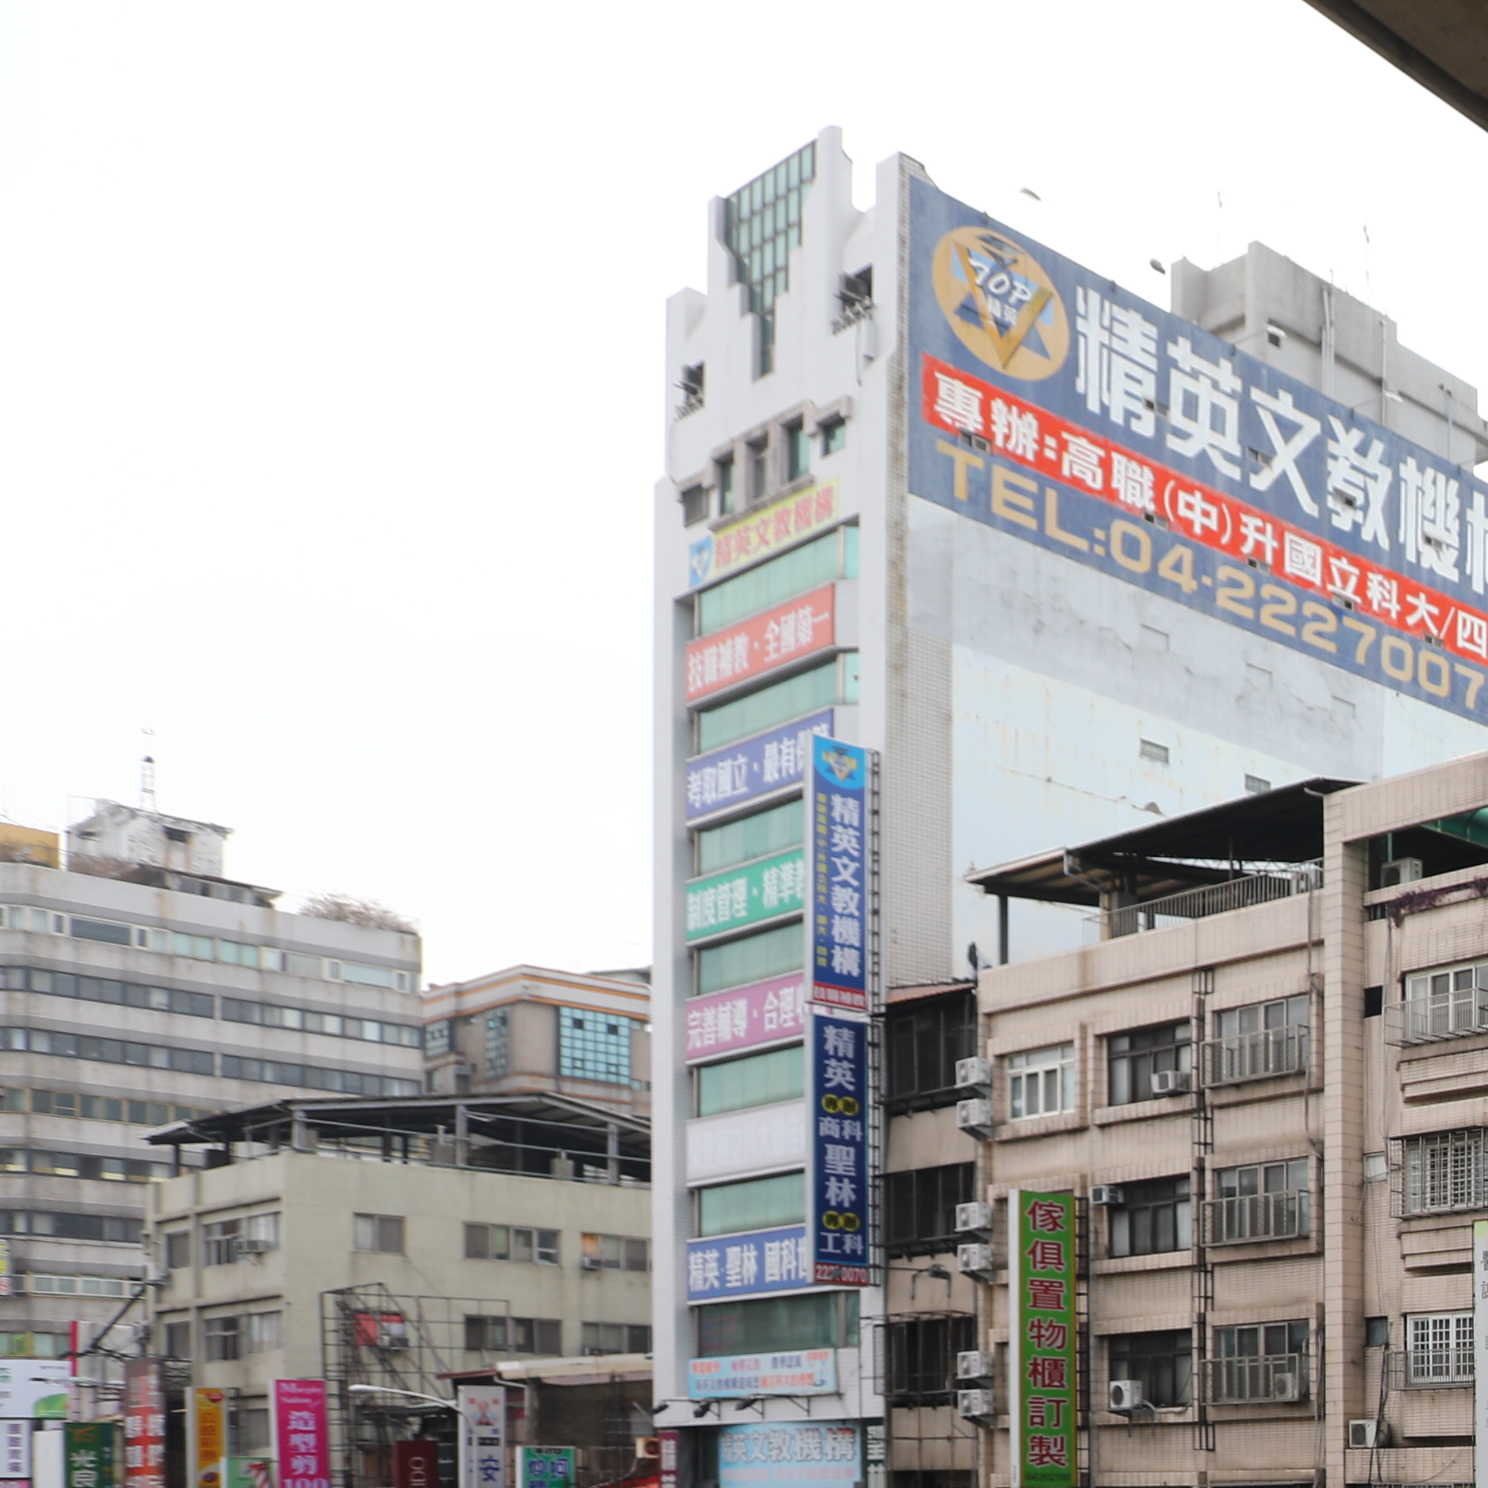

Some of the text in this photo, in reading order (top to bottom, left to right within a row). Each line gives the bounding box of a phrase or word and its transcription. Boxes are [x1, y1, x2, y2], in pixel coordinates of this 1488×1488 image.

[830, 793, 861, 978] 精英文教機構
[823, 1024, 856, 1092] 精英
[818, 1116, 863, 1142] 商科
[824, 1143, 857, 1208] 聖林
[819, 1231, 864, 1255] 工科
[1026, 1199, 1069, 1468] 傢俱置物櫃訂製
